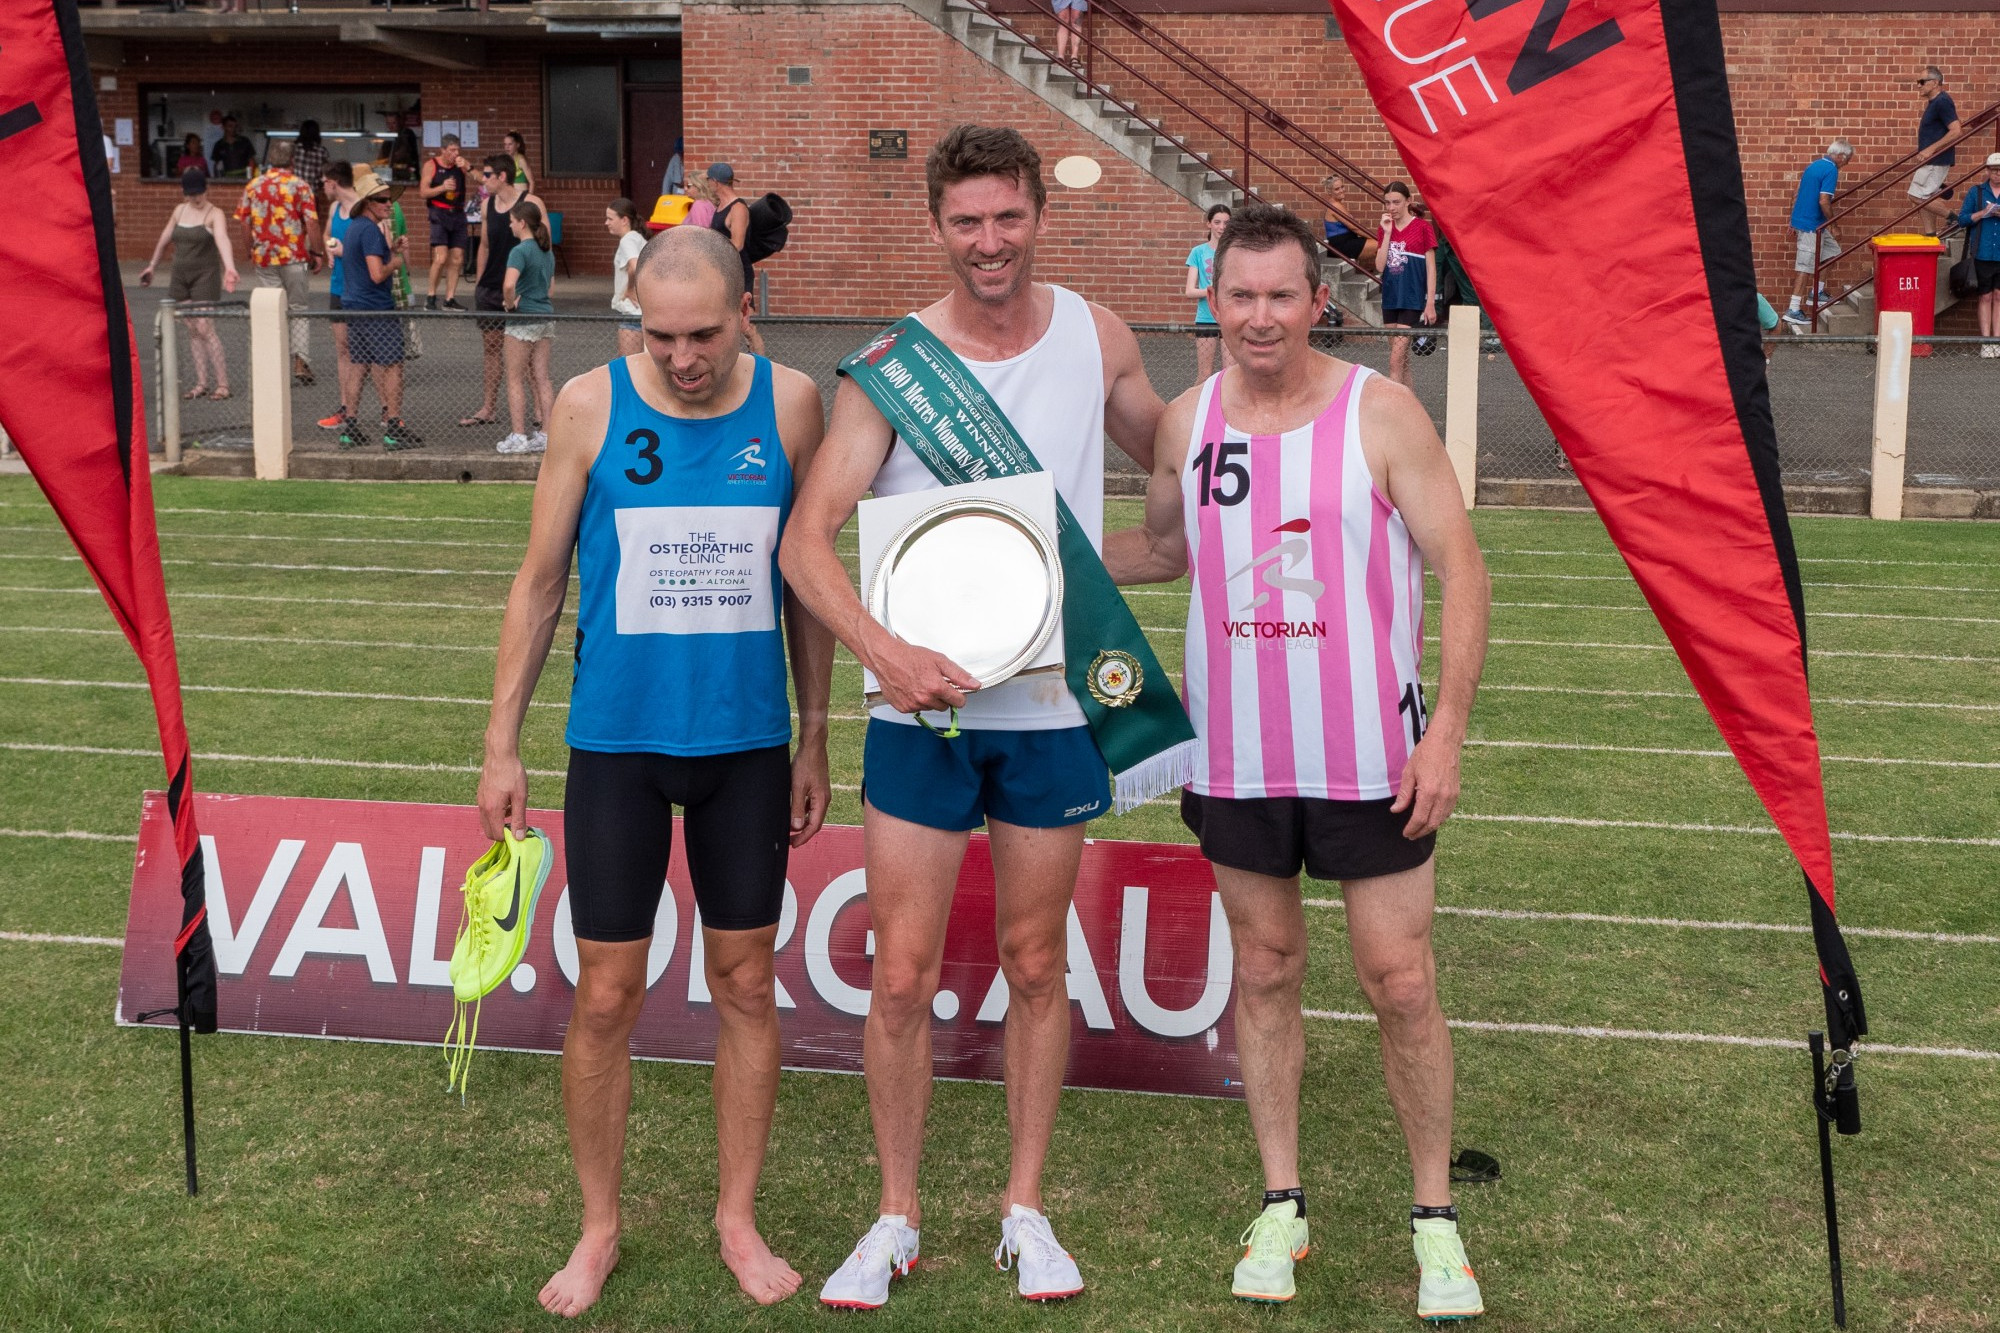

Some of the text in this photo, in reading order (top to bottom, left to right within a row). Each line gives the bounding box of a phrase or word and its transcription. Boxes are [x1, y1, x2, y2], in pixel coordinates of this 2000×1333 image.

[1376, 0, 1498, 134] UE
[879, 358, 913, 389] 1600
[900, 381, 939, 425] Metres
[911, 343, 932, 363] 162nd
[929, 360, 982, 422] MARYBOROUGH
[979, 420, 1017, 466] HIGHLAND
[956, 408, 1009, 475] WINNER
[623, 428, 664, 485] 3
[1192, 442, 1251, 507] 15
[688, 532, 716, 542] THE
[649, 542, 754, 554] OSTEOPATHIC
[679, 553, 726, 565] CLINIC
[649, 569, 712, 577] OSTEOPATHY
[649, 594, 753, 609] (03) 9315 9007
[1222, 620, 1327, 638] VICTORIAN
[1223, 638, 1328, 651] ATHLETIC LEAGUE
[1063, 800, 1100, 818] 2XU
